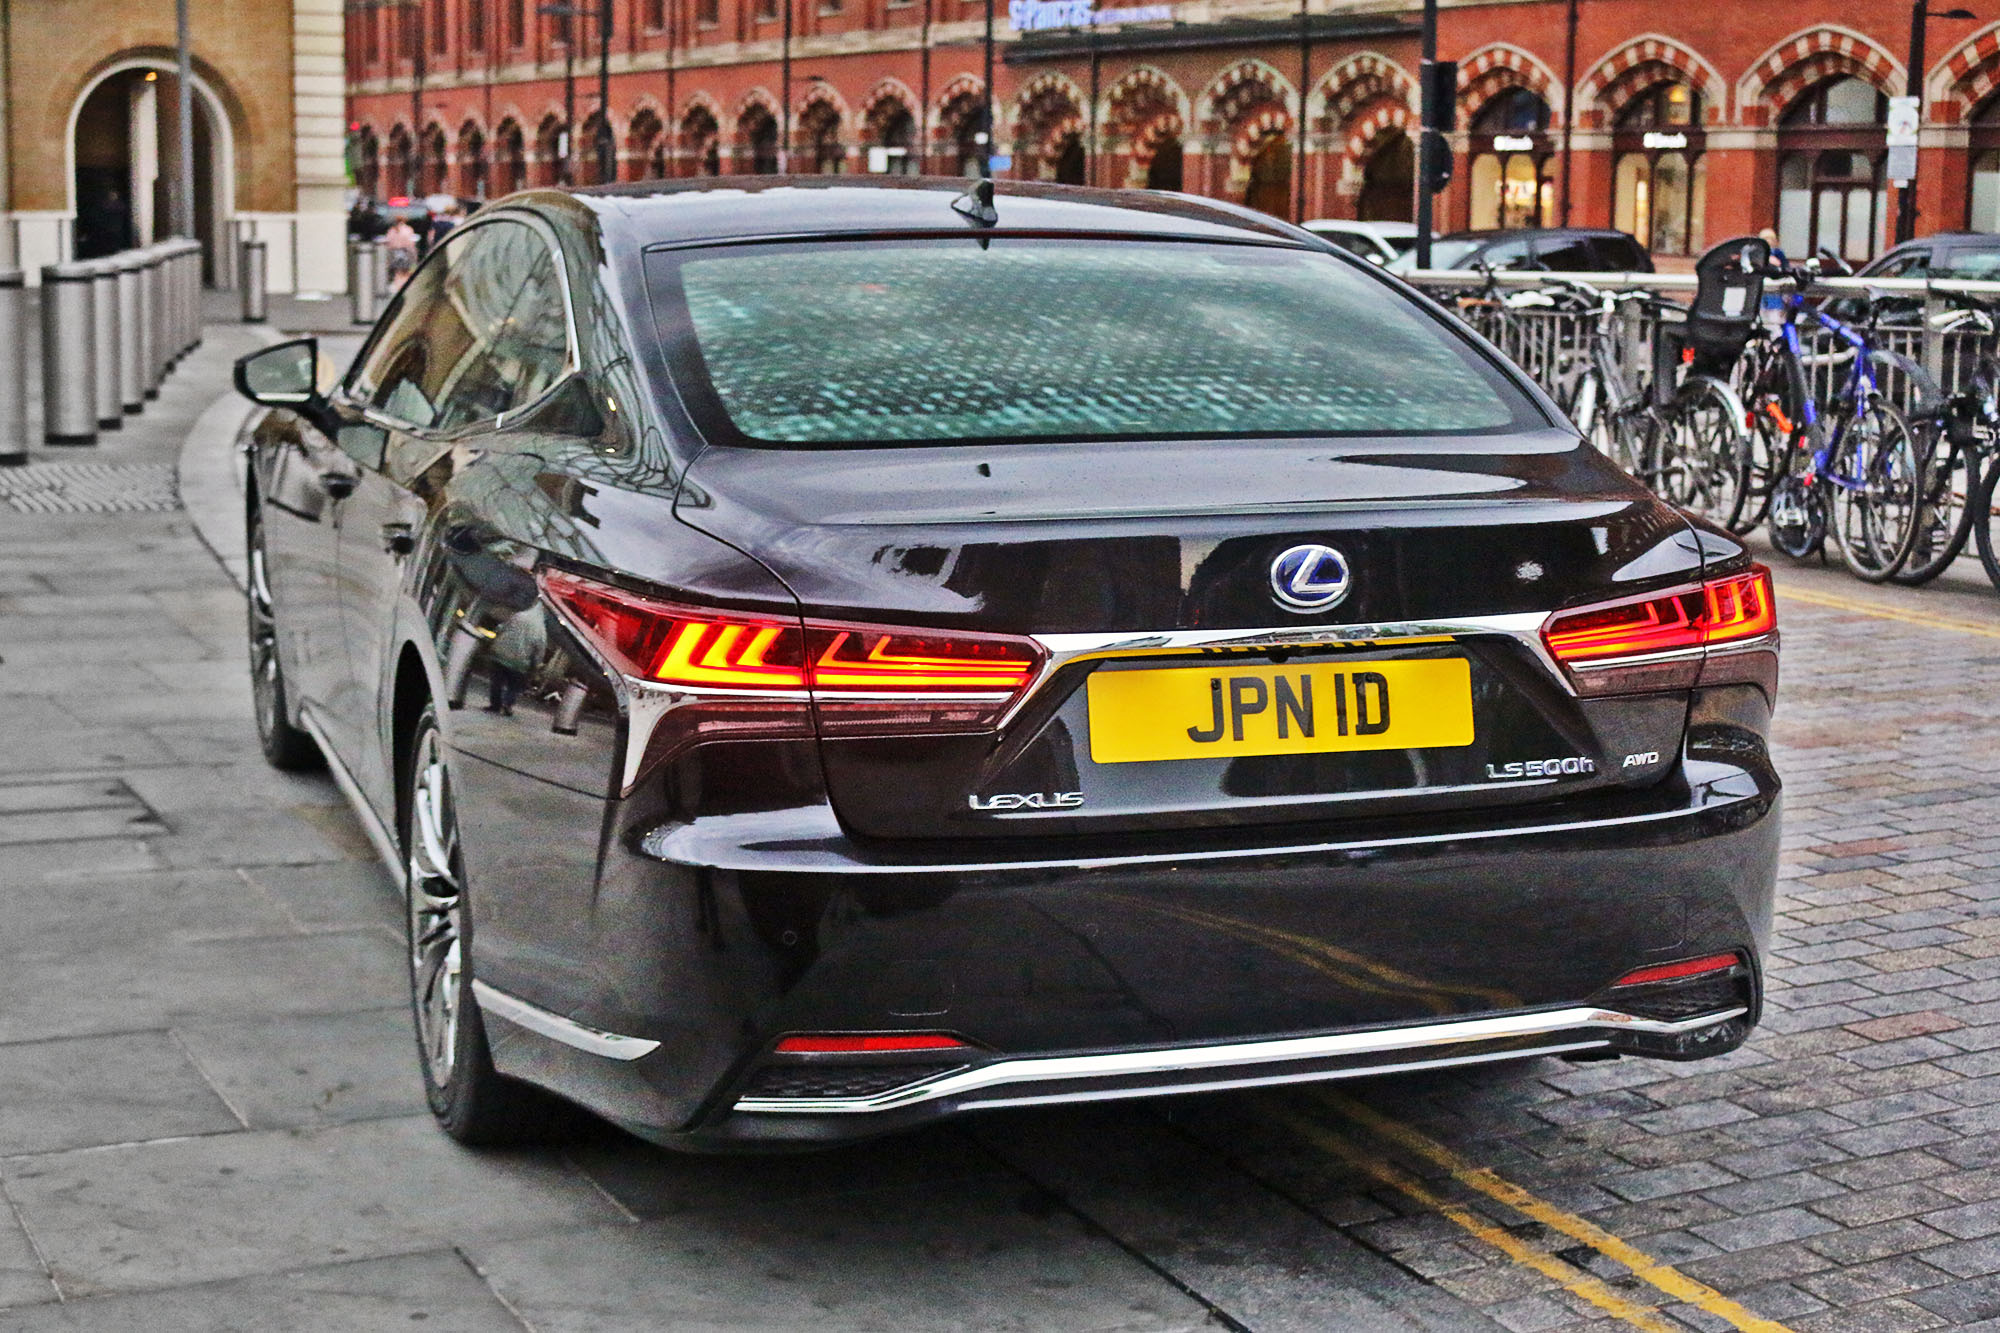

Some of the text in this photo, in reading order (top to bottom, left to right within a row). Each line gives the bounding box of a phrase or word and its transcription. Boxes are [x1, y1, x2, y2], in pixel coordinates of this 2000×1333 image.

[1187, 674, 1315, 743] JPN
[1622, 752, 1659, 767] AWD
[969, 792, 1084, 809] LEXUS
